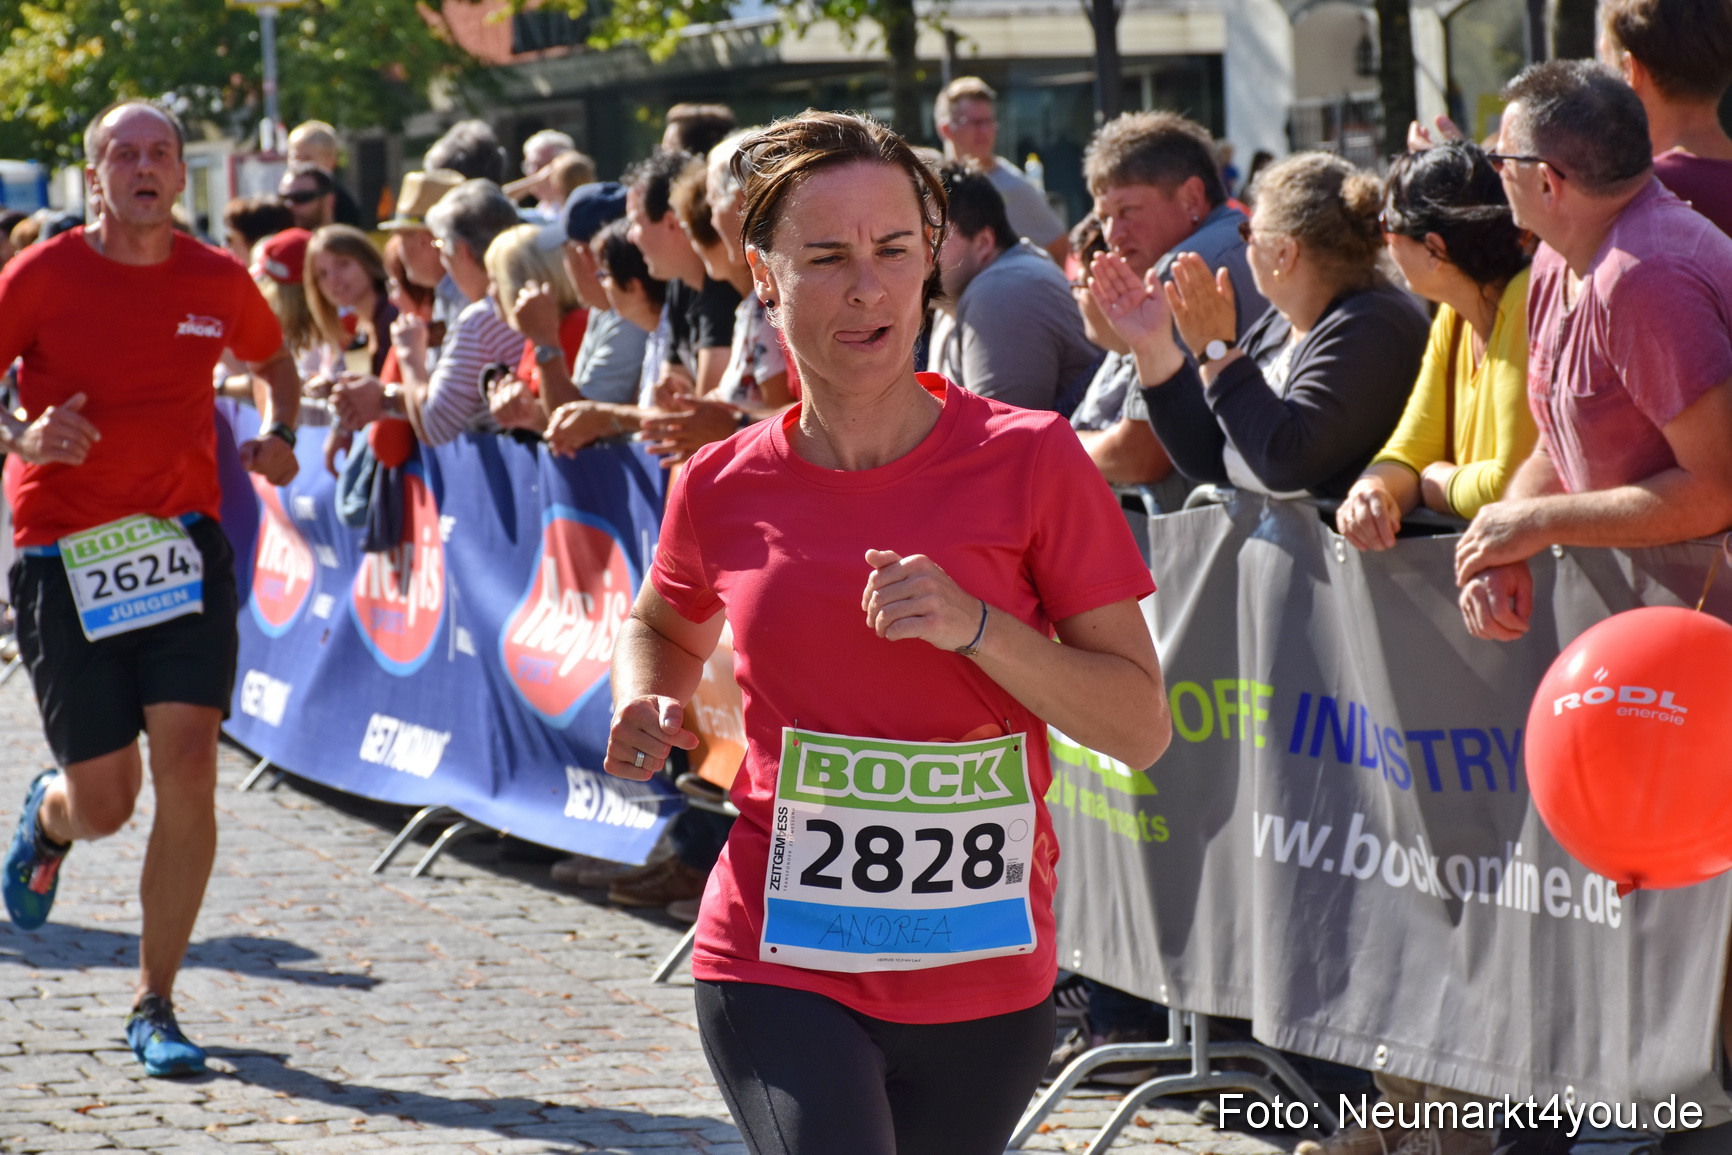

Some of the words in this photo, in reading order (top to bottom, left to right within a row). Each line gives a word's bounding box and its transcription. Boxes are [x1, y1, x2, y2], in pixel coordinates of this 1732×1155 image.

[74, 518, 182, 562] BOCK
[86, 546, 190, 600] 2624
[108, 589, 189, 622] JÜRGEN
[1553, 665, 1688, 717] RÖDL
[1616, 706, 1685, 726] energie
[1289, 692, 1524, 793] INDSTRY
[797, 743, 1012, 804] BOCK
[799, 819, 1005, 893] 2828
[818, 914, 952, 949] ANDREA
